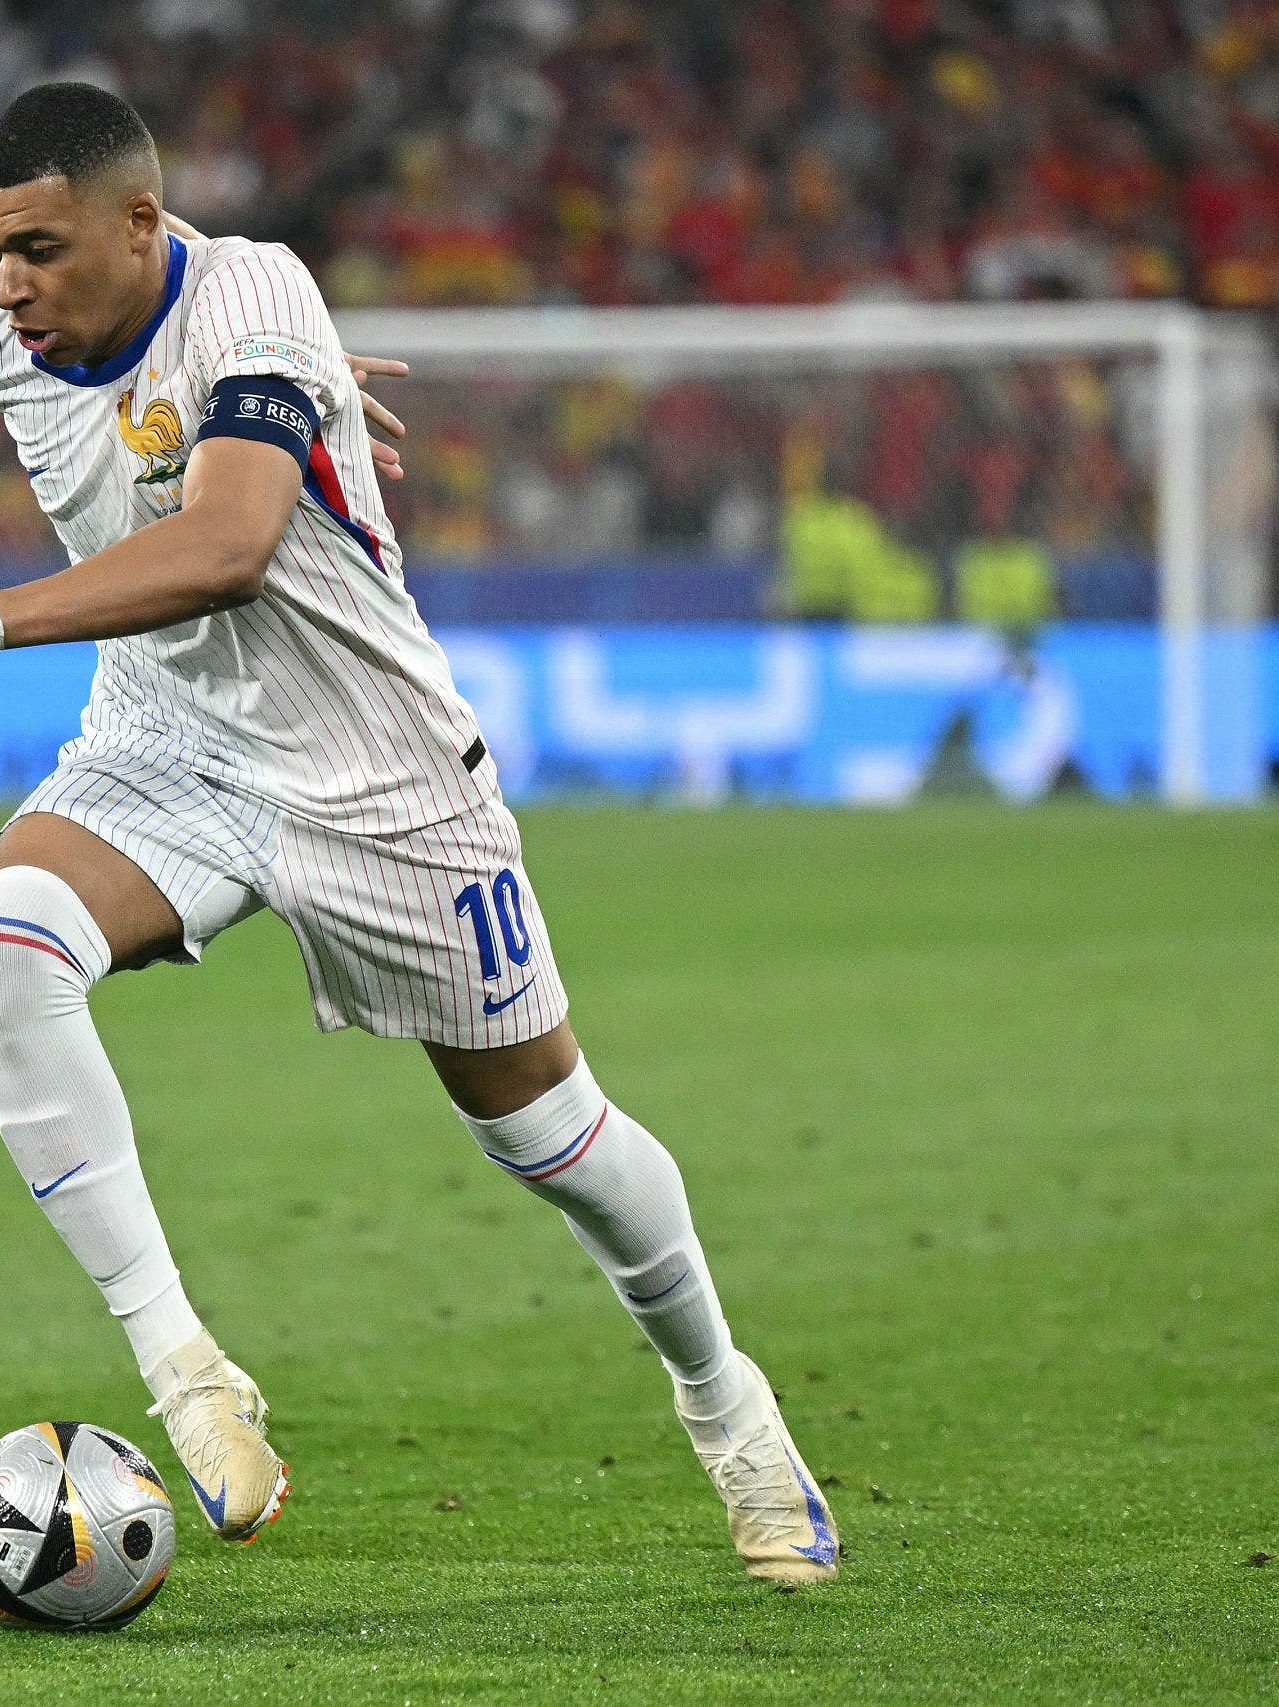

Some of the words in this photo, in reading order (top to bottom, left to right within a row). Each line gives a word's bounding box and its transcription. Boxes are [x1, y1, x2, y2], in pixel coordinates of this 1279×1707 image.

[234, 344, 312, 370] FOUNDATION
[267, 403, 311, 444] RESPE
[454, 868, 533, 980] 10
